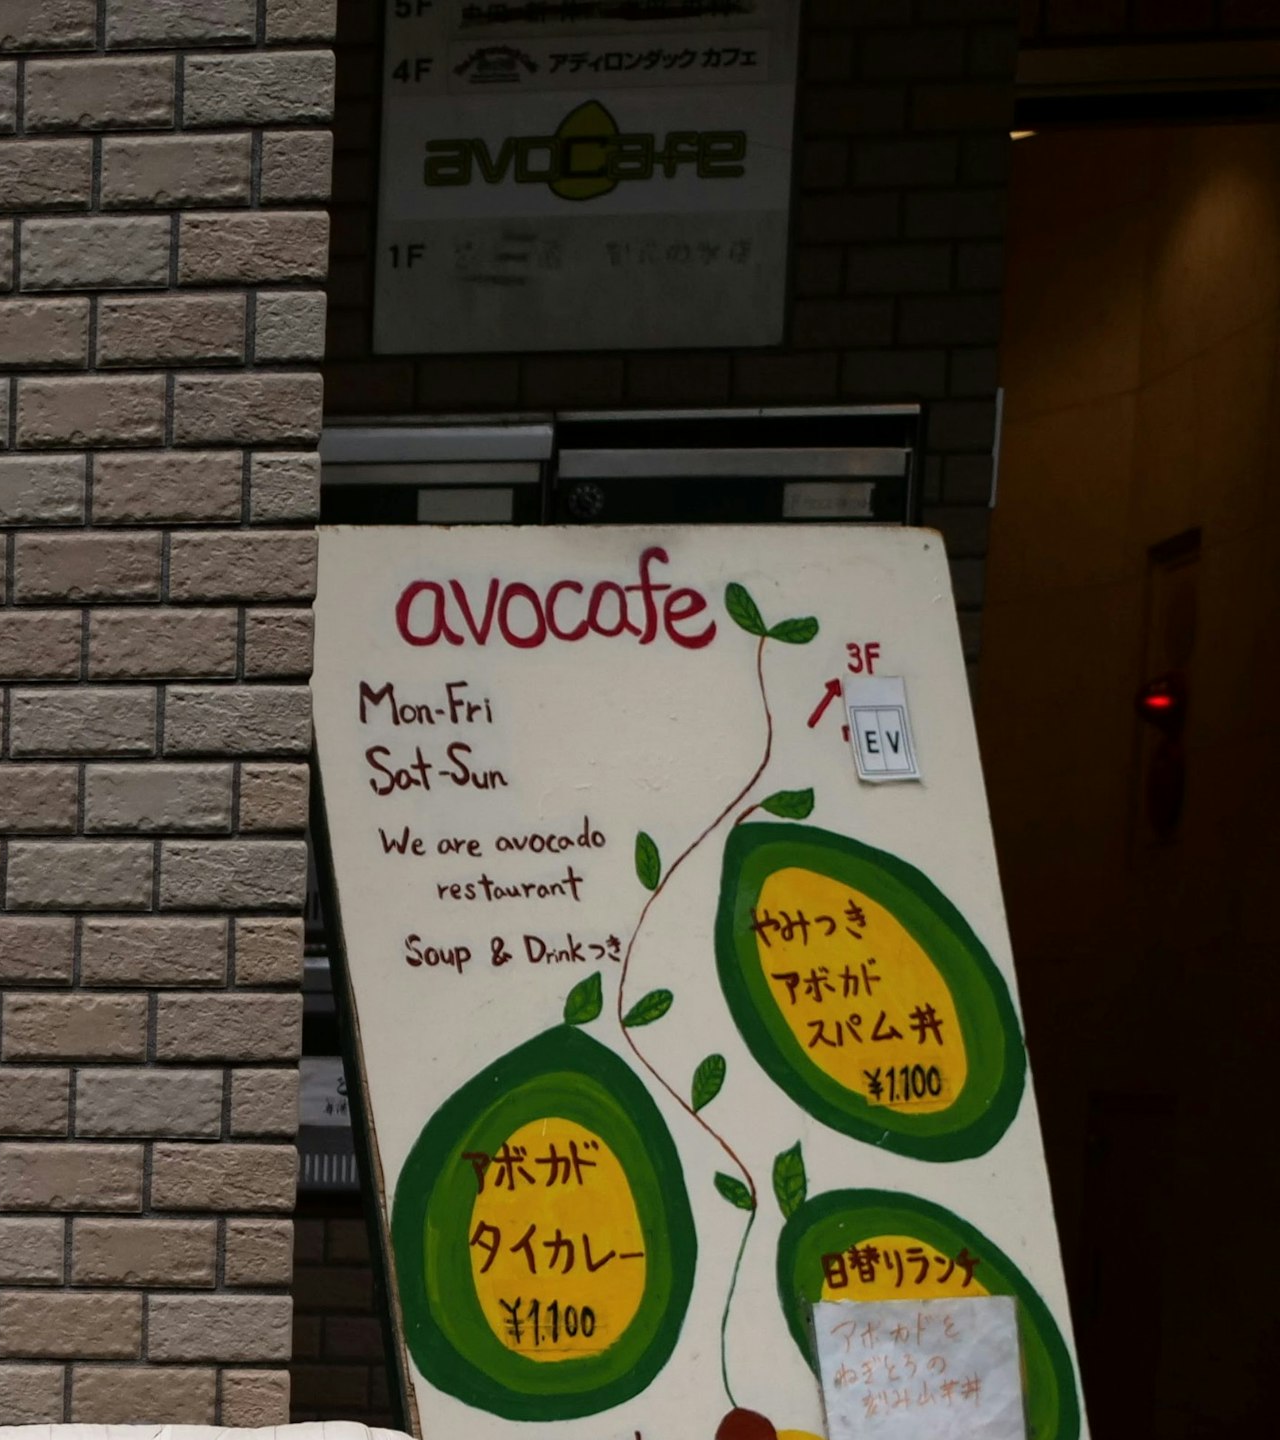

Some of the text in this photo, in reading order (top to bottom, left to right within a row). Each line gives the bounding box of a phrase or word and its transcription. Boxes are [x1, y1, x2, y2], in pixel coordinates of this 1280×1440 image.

[392, 58, 433, 84] 4F
[548, 47, 697, 74] アディロンダック
[701, 46, 758, 69] カフェ
[424, 130, 748, 187] avocafe
[387, 244, 425, 270] 1F
[396, 546, 717, 650] avocafe
[846, 642, 881, 675] 3F
[378, 815, 607, 857] We are avocado
[437, 865, 584, 902] restaurant
[750, 898, 867, 948] やみつき
[405, 934, 472, 974] Soup
[491, 936, 513, 966] &
[771, 957, 882, 1006] アボカド
[461, 1139, 600, 1195] アボカド
[469, 1219, 645, 1275] タイカレー
[820, 1244, 982, 1290] 日替りランチ
